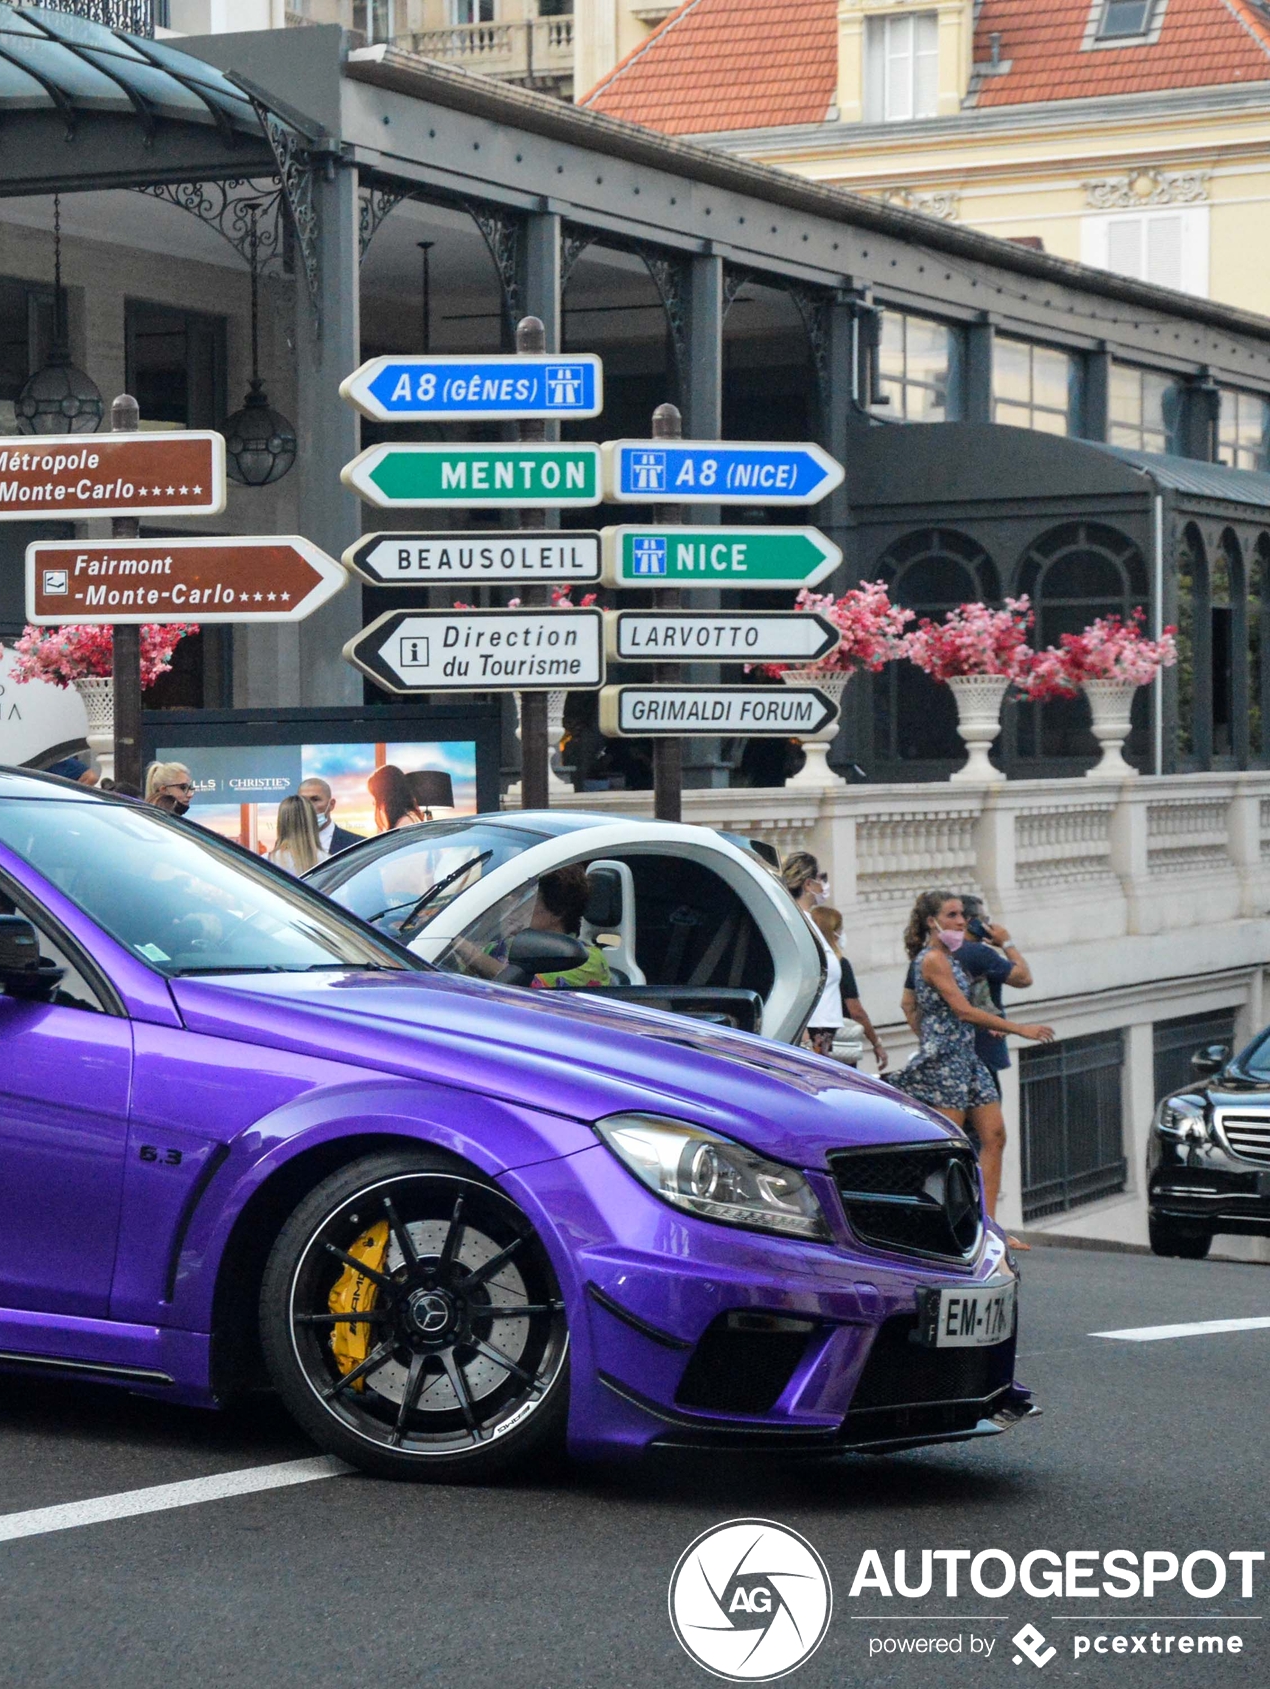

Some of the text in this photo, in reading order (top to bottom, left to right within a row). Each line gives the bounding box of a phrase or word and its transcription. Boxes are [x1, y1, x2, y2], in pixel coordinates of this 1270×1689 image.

[390, 373, 538, 403] A8 (GÊNES)
[441, 461, 585, 489] MENTON
[675, 459, 798, 490] A8 (NICE)
[74, 555, 173, 576] Fairmont
[398, 547, 584, 570] BEAUSOLEIL
[676, 543, 748, 571] NICE
[74, 583, 235, 606] -Monte-Carlo
[443, 625, 578, 648] Direction
[631, 626, 759, 647] LARVOTTO
[443, 654, 582, 677] du Tourisme
[632, 700, 813, 721] GRIMALDI FORUM
[192, 780, 216, 788] LLS
[229, 778, 291, 787] CHRISTIE'S
[139, 1145, 182, 1165] 6.3
